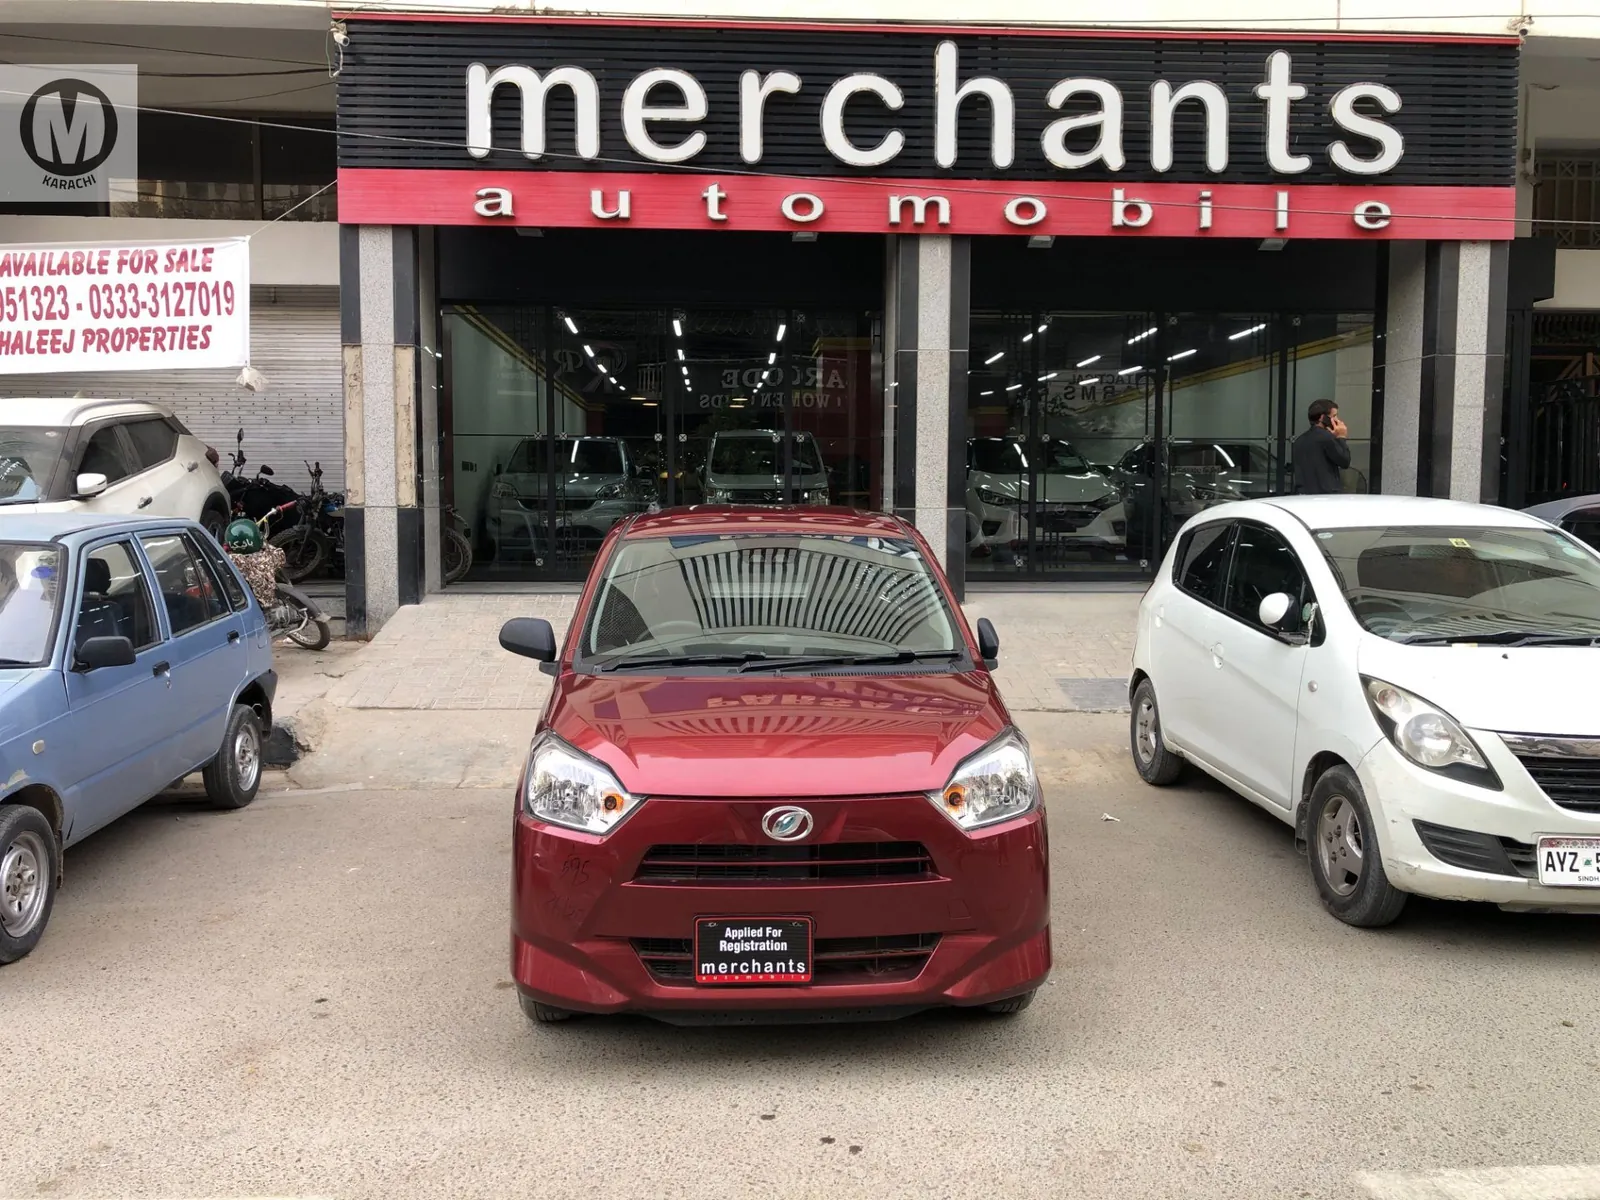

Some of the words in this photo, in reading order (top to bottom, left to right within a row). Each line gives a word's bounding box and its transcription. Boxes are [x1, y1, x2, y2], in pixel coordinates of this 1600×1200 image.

[466, 39, 1405, 176] merchants
[474, 183, 1392, 230] automobile
[0, 249, 111, 277] AVAILABLE
[117, 249, 159, 275] FOR
[164, 247, 215, 273] SALE
[89, 280, 235, 320] 0333-3127019
[82, 325, 213, 354] PROPERTIES
[1545, 851, 1580, 872] AYZ
[719, 939, 788, 954] Registration
[725, 927, 763, 940] Applied
[766, 927, 783, 938] For
[701, 959, 806, 974] merchants
